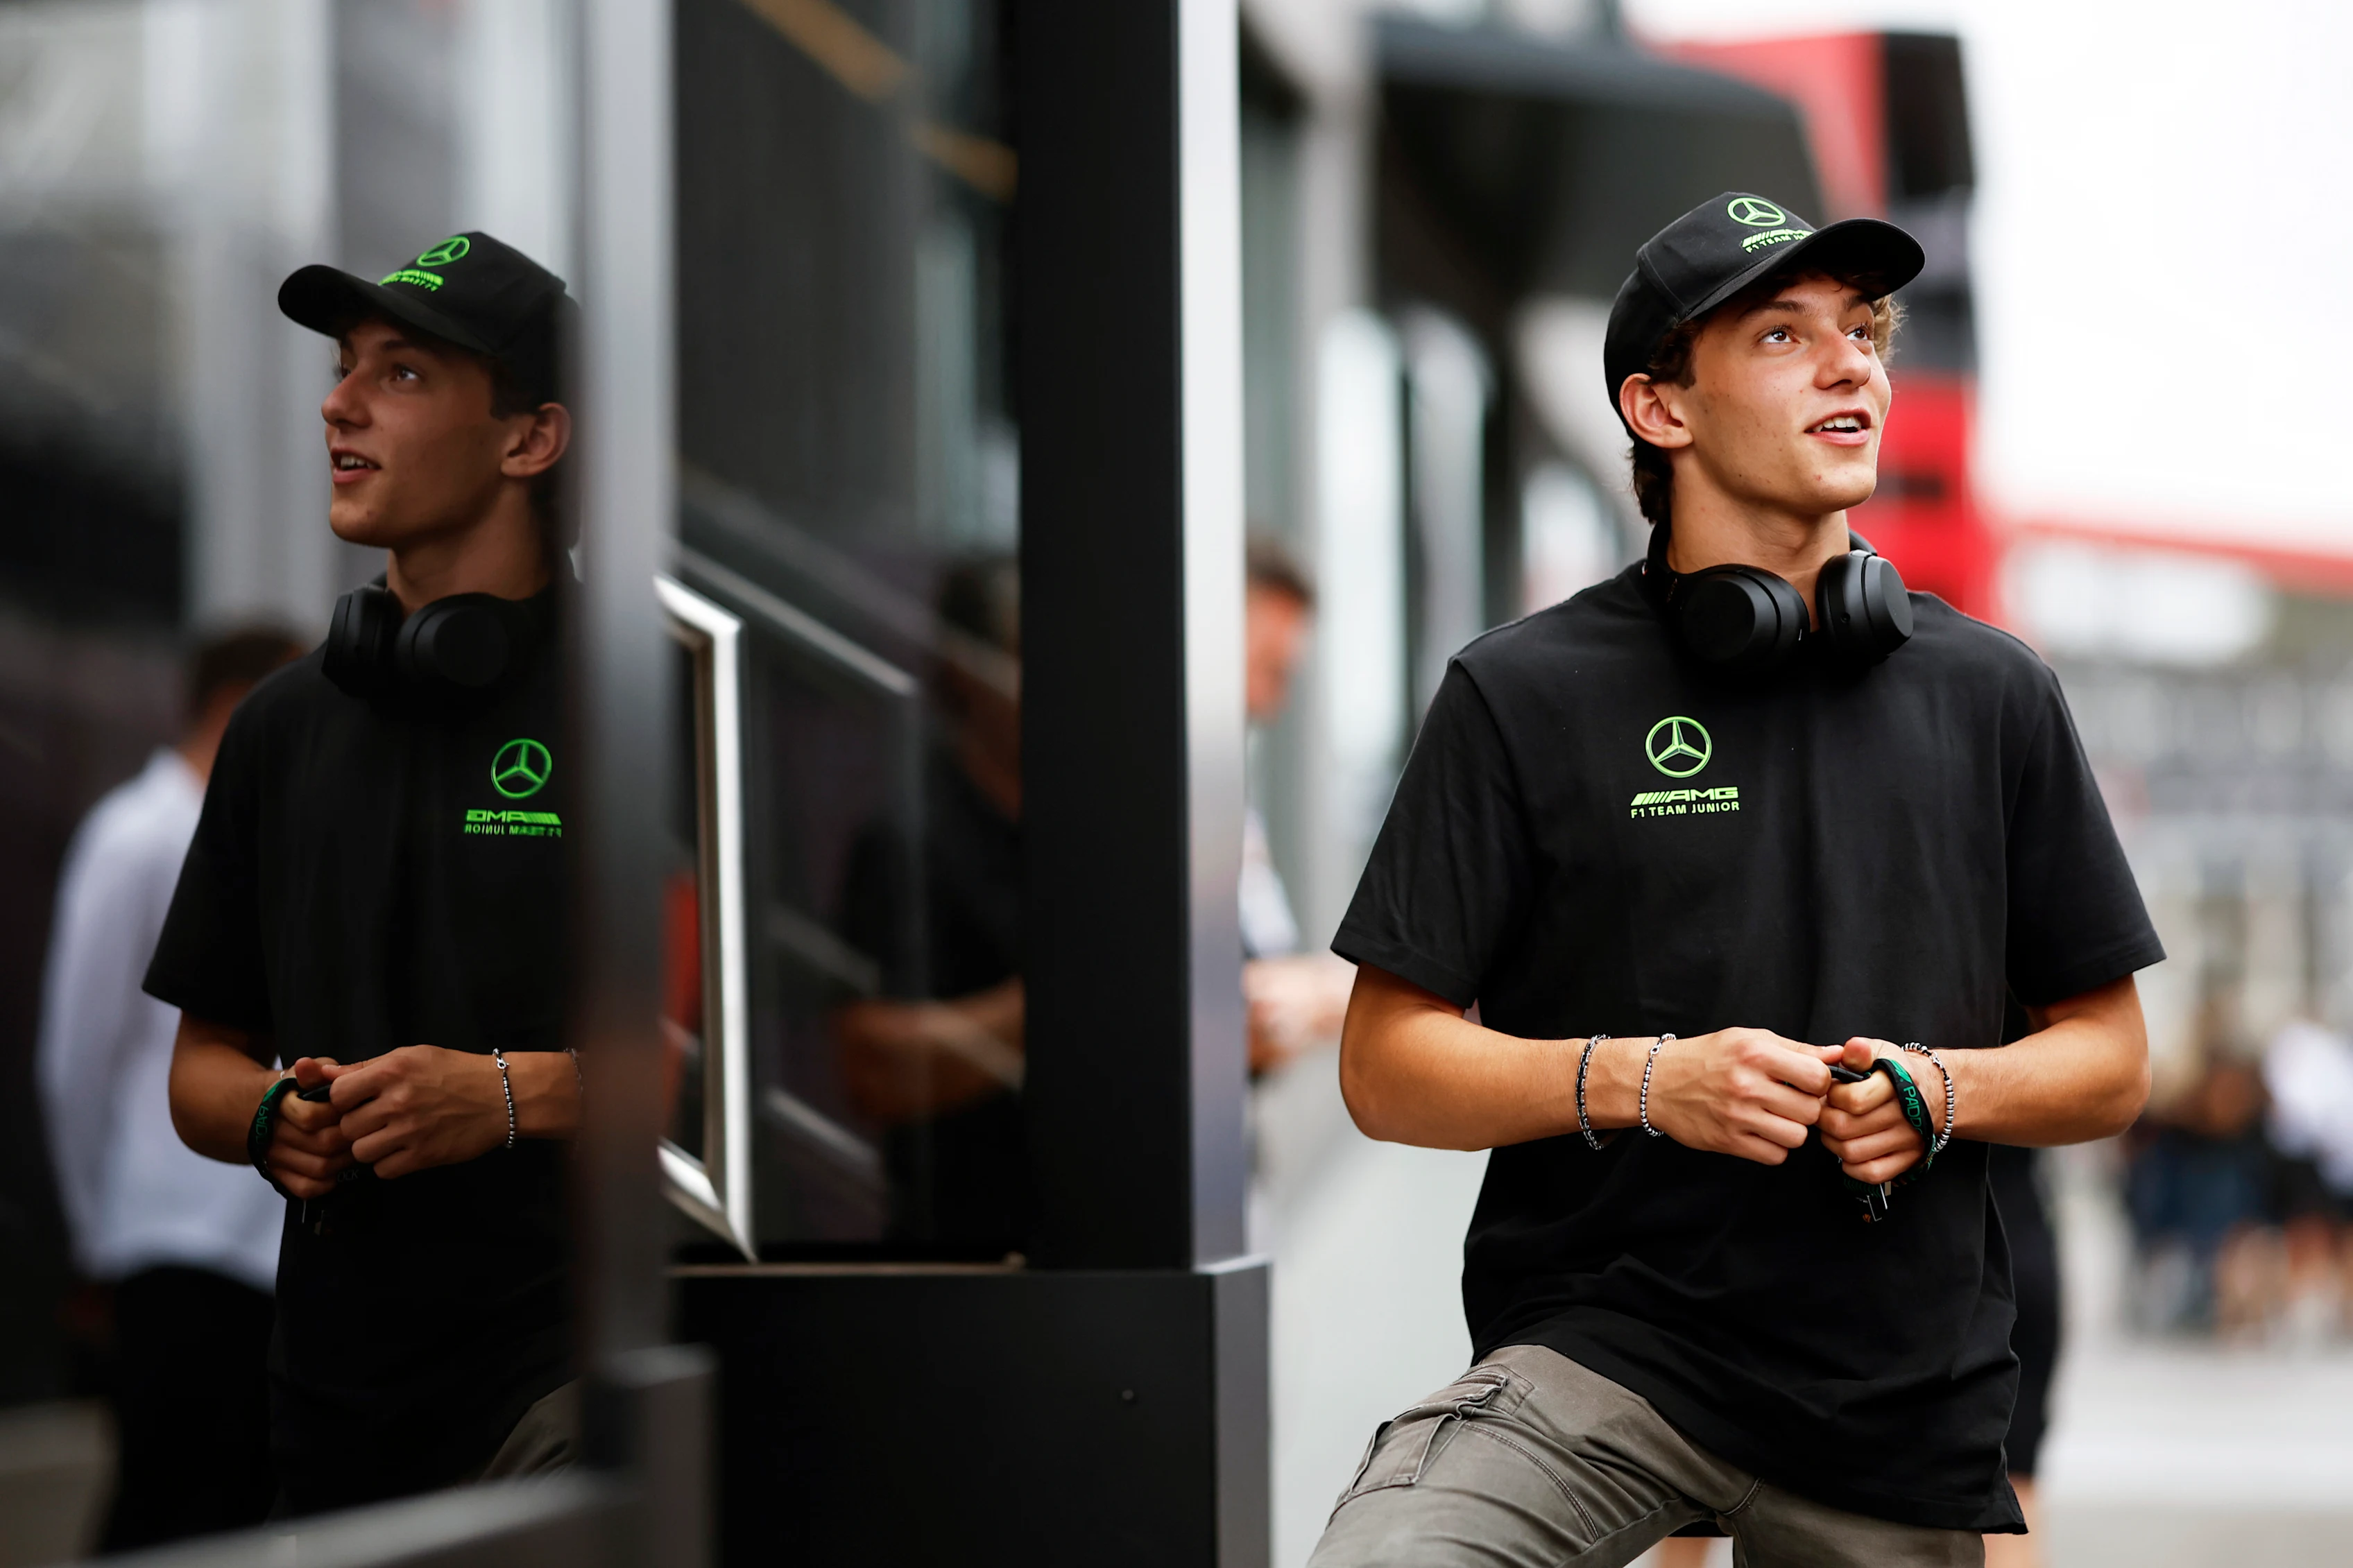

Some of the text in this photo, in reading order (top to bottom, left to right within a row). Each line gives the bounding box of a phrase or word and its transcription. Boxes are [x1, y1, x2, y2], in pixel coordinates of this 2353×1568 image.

[1760, 236, 1791, 246] TEAM
[1665, 787, 1739, 803] AMG
[1631, 801, 1740, 818] F1 TEAM JUNIOR
